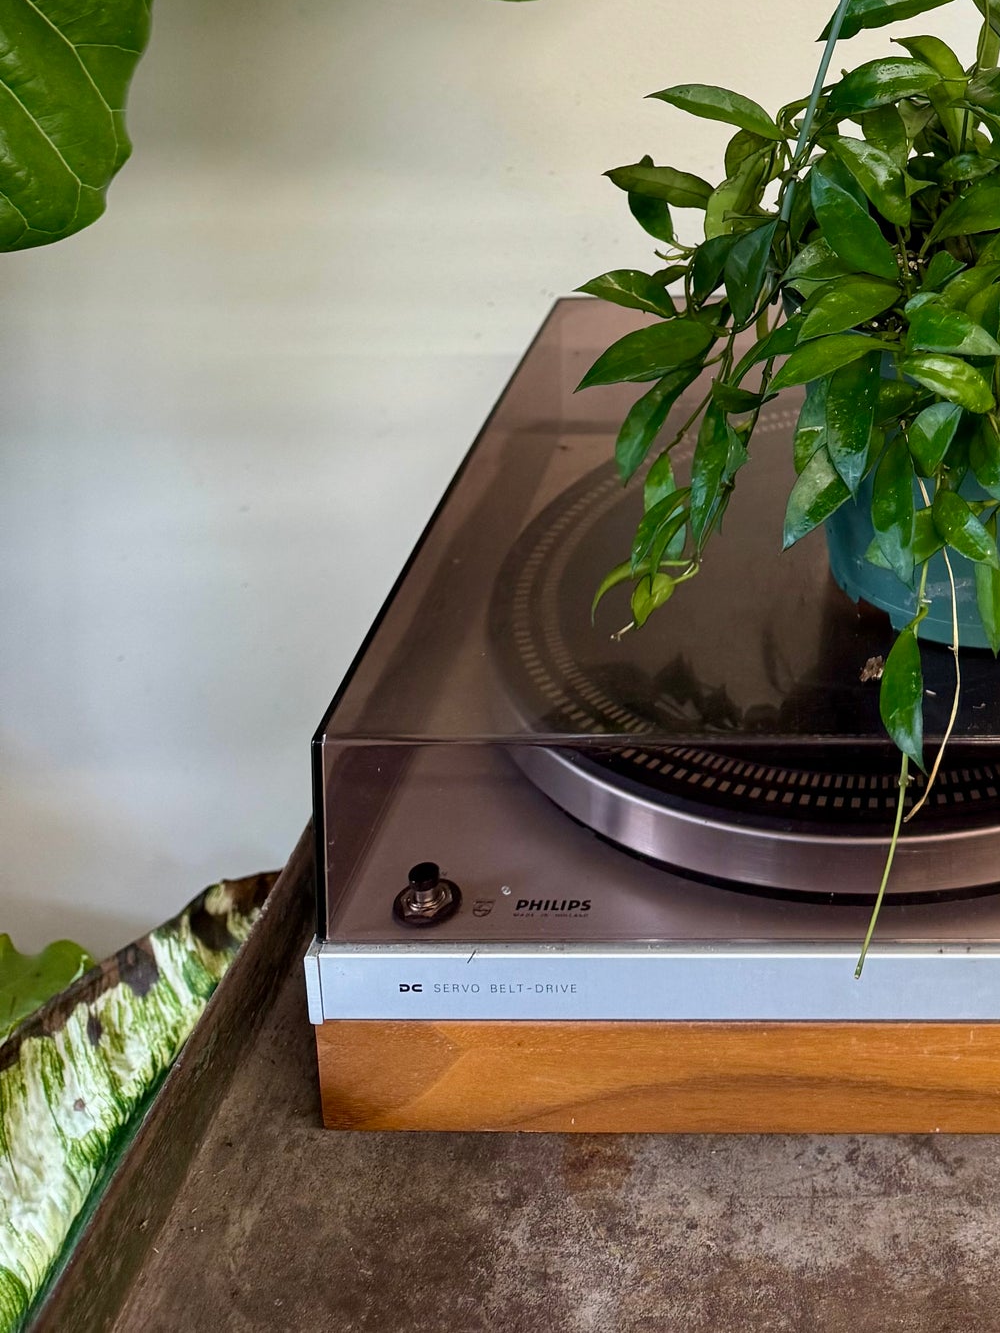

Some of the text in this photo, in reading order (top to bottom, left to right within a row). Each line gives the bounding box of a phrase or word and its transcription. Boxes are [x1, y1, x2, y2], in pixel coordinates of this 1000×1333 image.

[515, 899, 592, 911] PHILIPS
[399, 983, 577, 993] DC SERVO BELT-DRIVE
